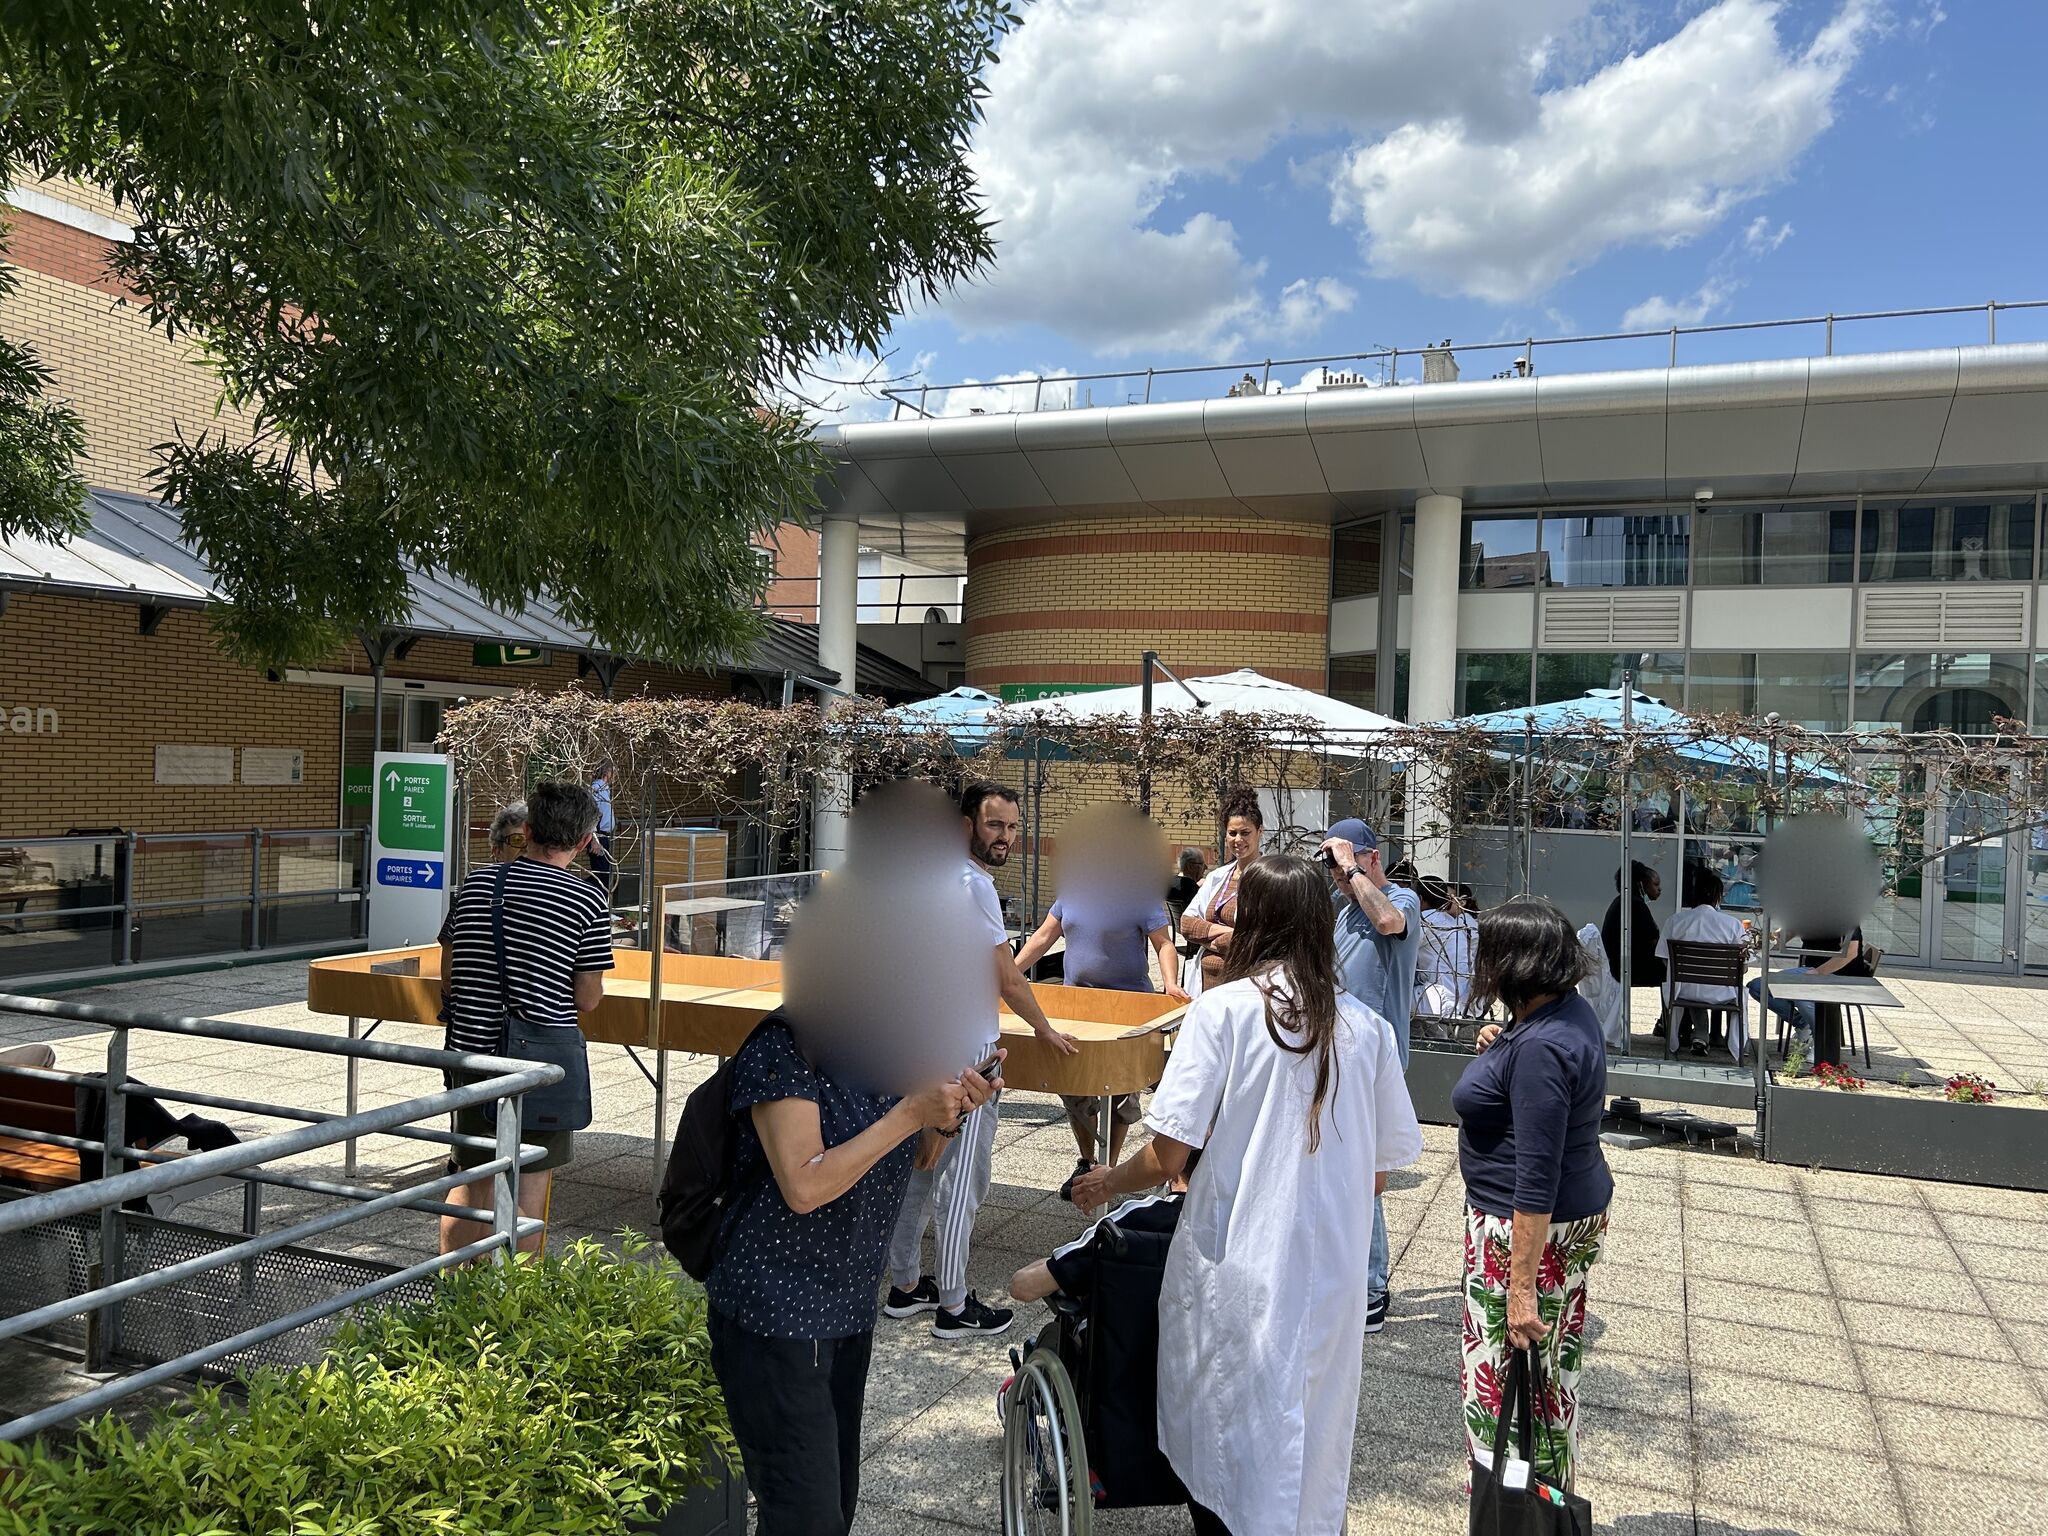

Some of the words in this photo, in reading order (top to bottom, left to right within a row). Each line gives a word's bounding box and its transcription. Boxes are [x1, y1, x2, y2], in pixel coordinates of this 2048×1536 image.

[404, 776, 430, 785] PORTES
[347, 785, 373, 794] PORTE
[403, 785, 425, 794] PAIRES
[402, 814, 427, 823] SORTIE
[387, 865, 413, 874] PORTES
[385, 874, 413, 883] IMPAIRES
